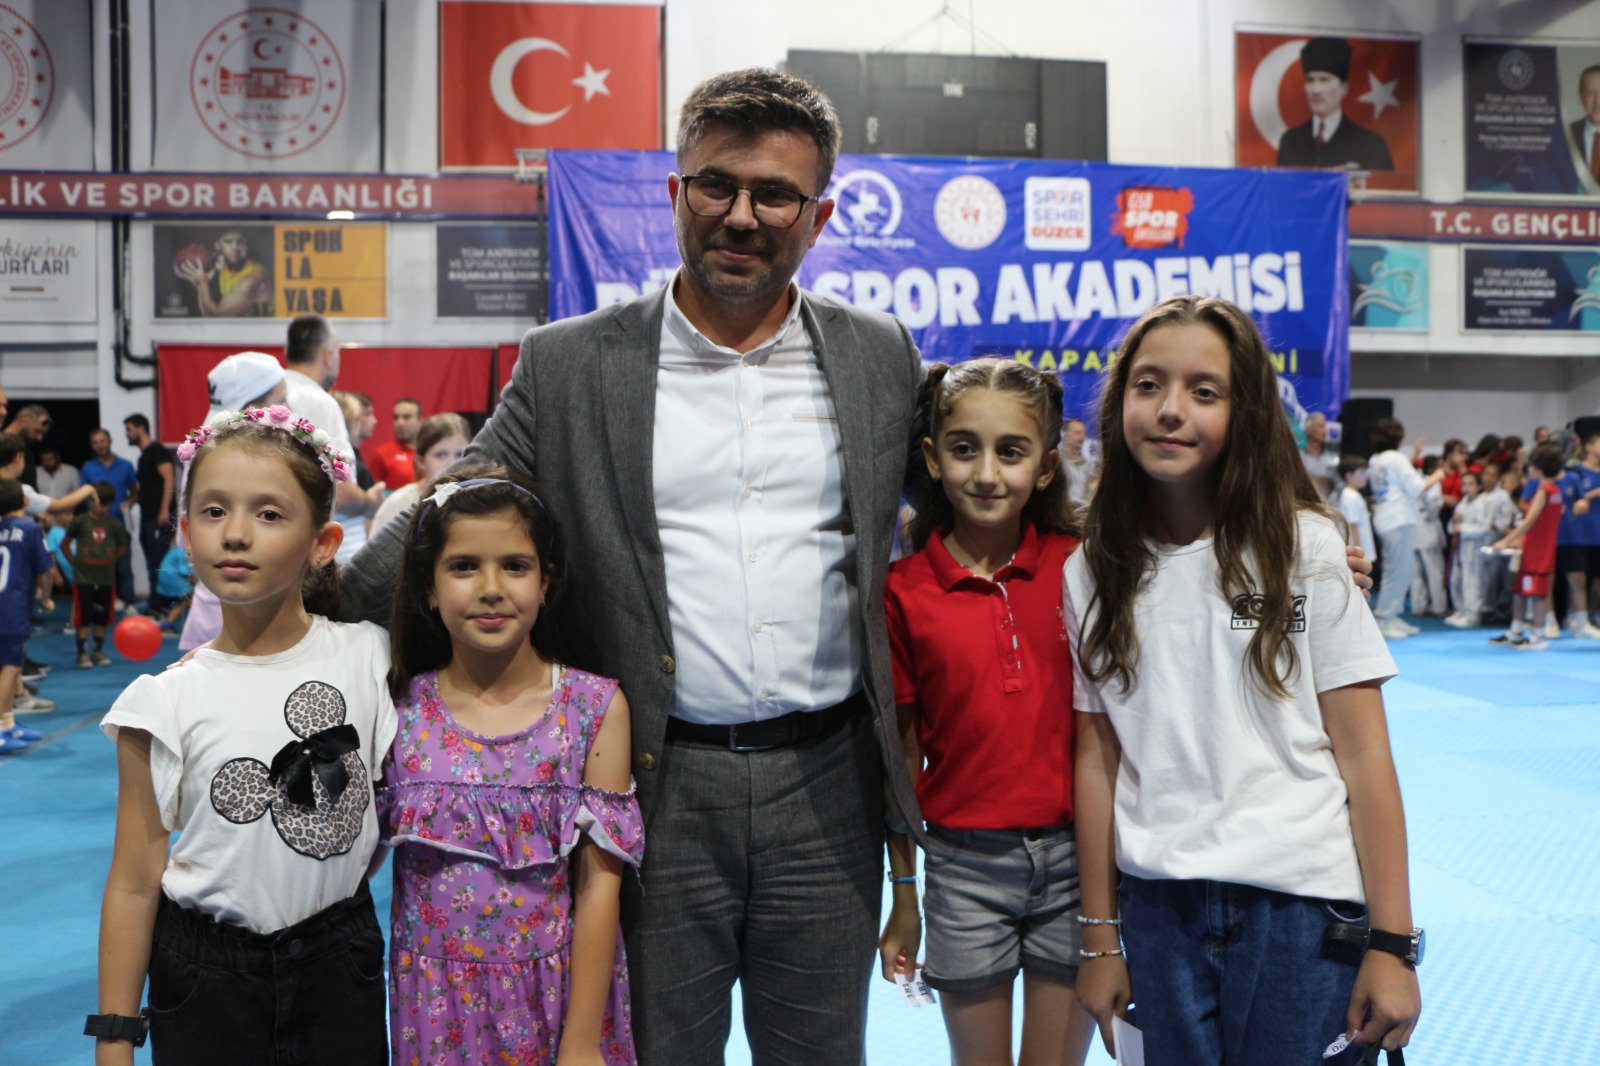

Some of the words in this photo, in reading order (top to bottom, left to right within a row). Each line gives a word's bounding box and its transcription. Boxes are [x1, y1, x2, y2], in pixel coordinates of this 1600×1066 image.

[60, 182, 106, 207] VE
[119, 182, 215, 208] SPOR
[229, 178, 433, 209] BAKANLIĞI
[1032, 223, 1085, 239] DÜZCE
[1124, 211, 1179, 228] SPOR
[1430, 211, 1482, 234] T.C.
[1491, 211, 1600, 240] GENÇLİ
[283, 229, 343, 253] SPOR
[285, 257, 312, 280] LA
[284, 288, 343, 315] YAŞA
[813, 267, 982, 330] SPOR
